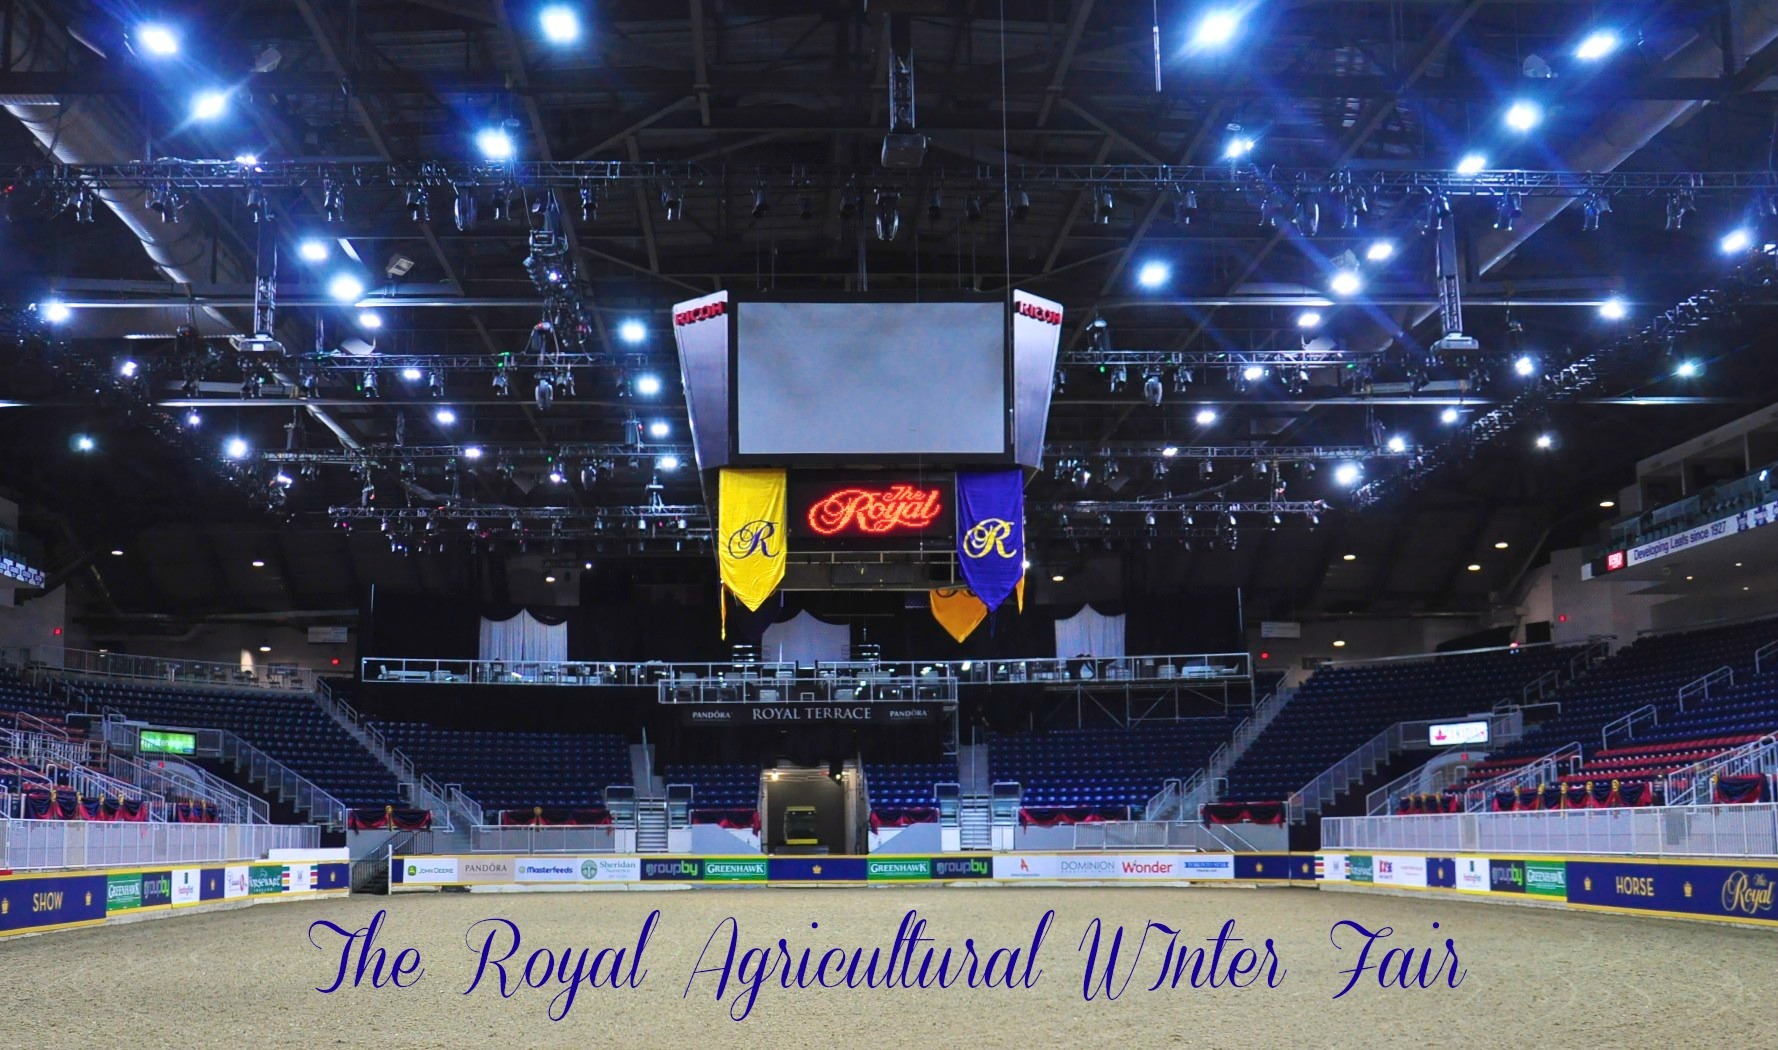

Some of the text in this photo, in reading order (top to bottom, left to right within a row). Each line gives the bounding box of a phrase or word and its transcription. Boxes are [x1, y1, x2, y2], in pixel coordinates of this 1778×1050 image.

[675, 301, 728, 326] RICOH
[1015, 301, 1062, 325] RICOH
[882, 485, 927, 503] The
[808, 489, 942, 534] Royal
[1633, 541, 1669, 561] Developing
[1690, 529, 1709, 543] since
[1711, 520, 1727, 536] 1927
[752, 707, 871, 720] ROYAL TERRACE
[526, 866, 573, 874] Masterfeeds
[599, 861, 636, 869] Sheridan
[645, 860, 699, 876] groupby
[706, 863, 764, 874] GREENHAWK
[870, 863, 927, 873] GREENHAWK
[936, 859, 988, 874] groupby
[1060, 861, 1115, 871] DOMINION
[1121, 860, 1173, 874] Wonder
[1492, 863, 1523, 886] groupby
[108, 882, 141, 899] GREENHAWK
[143, 875, 170, 899] groupby
[1616, 875, 1654, 896] HORSE
[1722, 870, 1776, 914] Royal
[32, 891, 64, 912] SHOW
